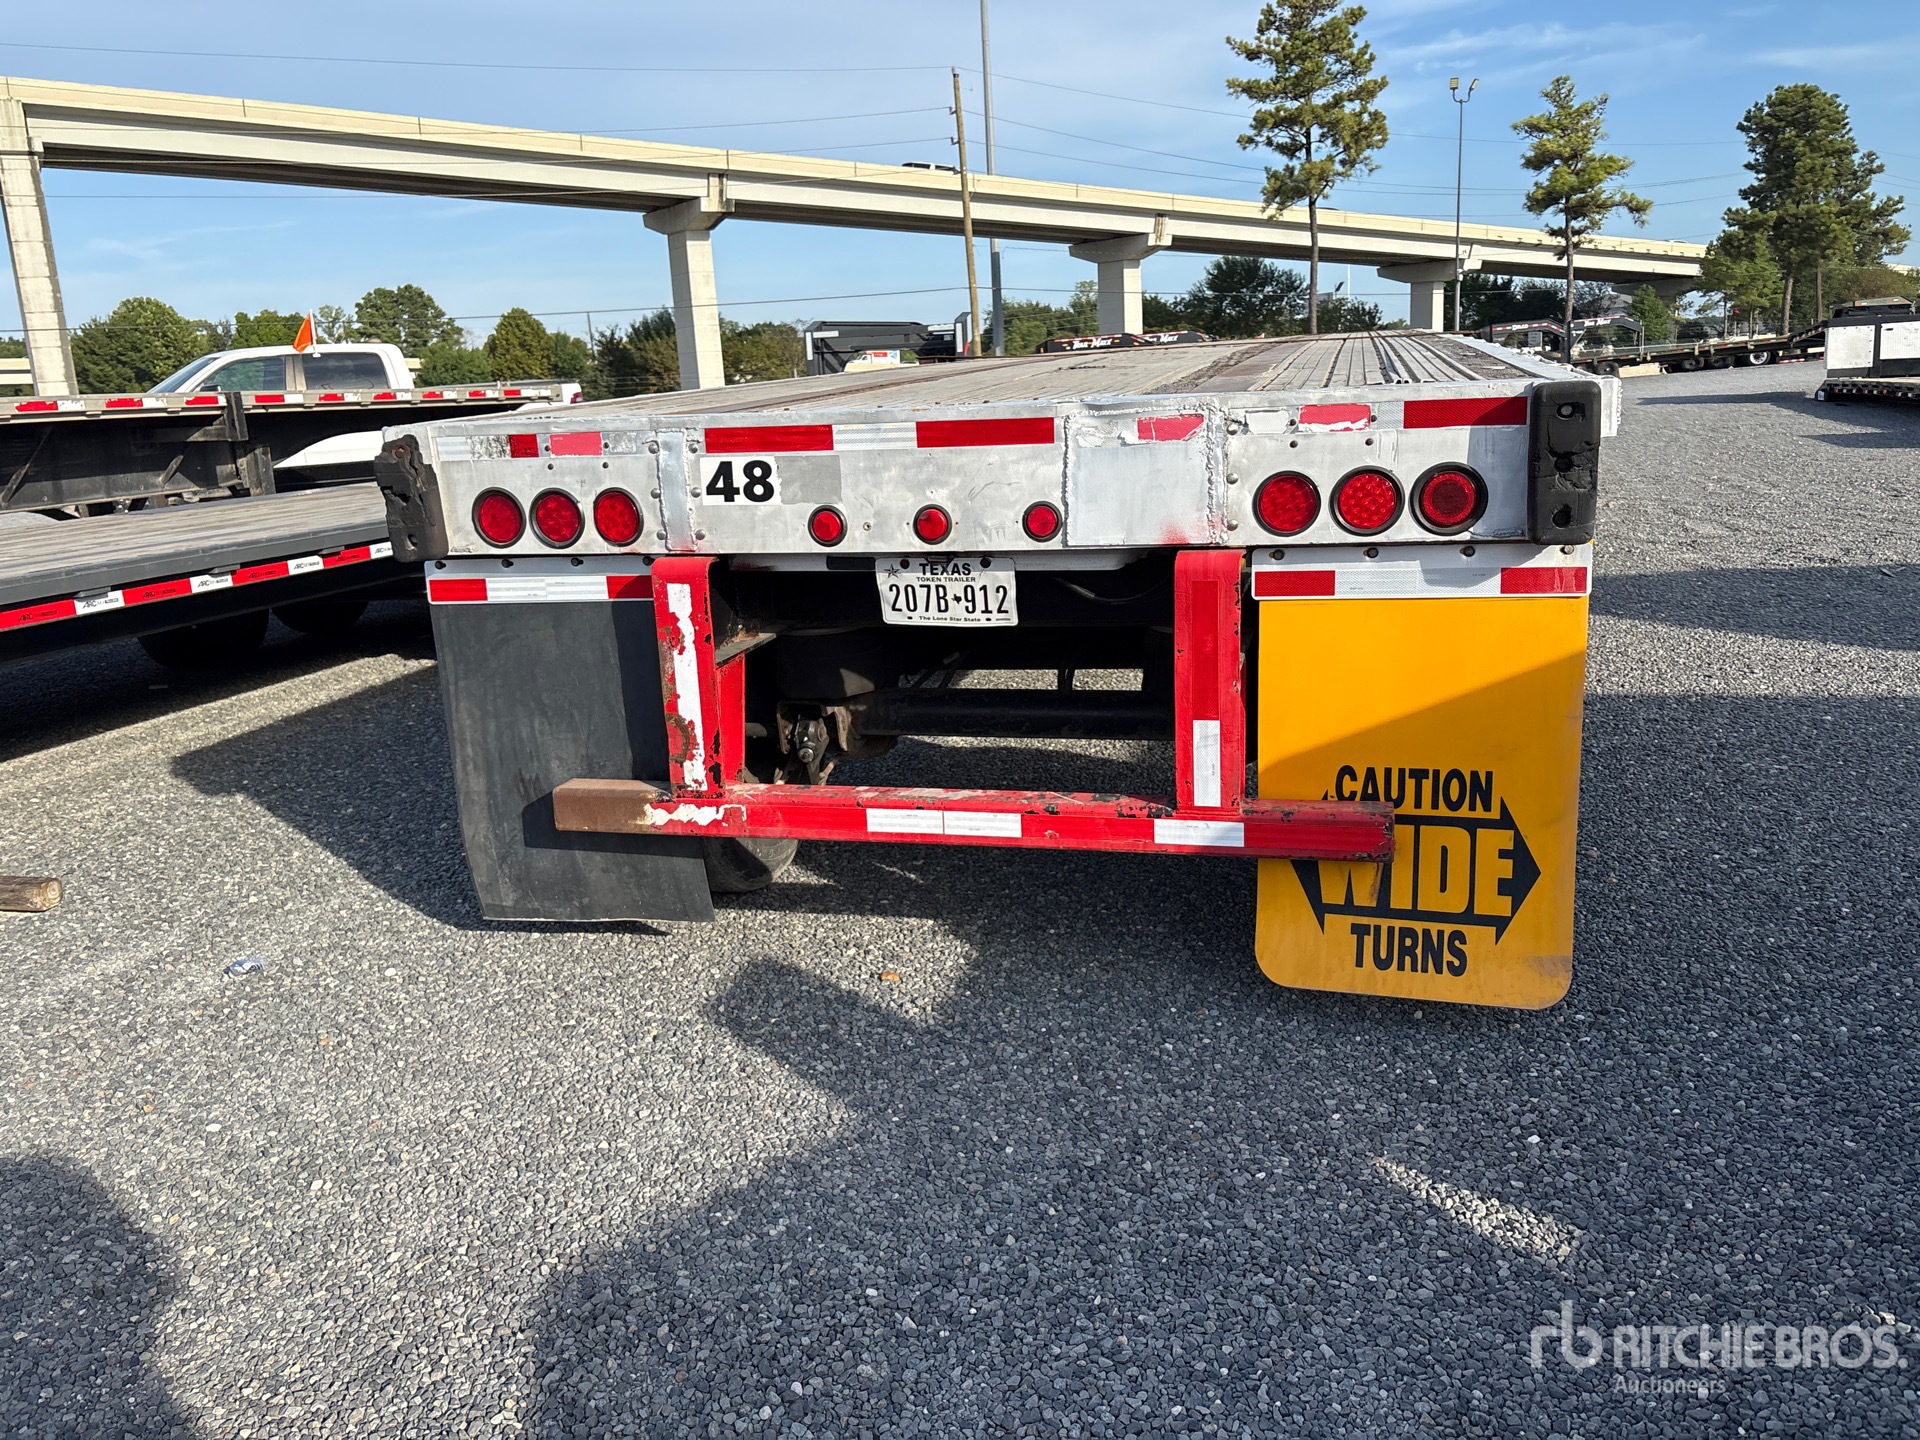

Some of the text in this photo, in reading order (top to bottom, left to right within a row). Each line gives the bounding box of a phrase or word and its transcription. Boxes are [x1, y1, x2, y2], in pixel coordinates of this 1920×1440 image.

[706, 460, 774, 502] 48
[918, 563, 972, 576] TEXAS
[1335, 765, 1493, 812] CAUTION
[1350, 922, 1467, 977] TURNS
